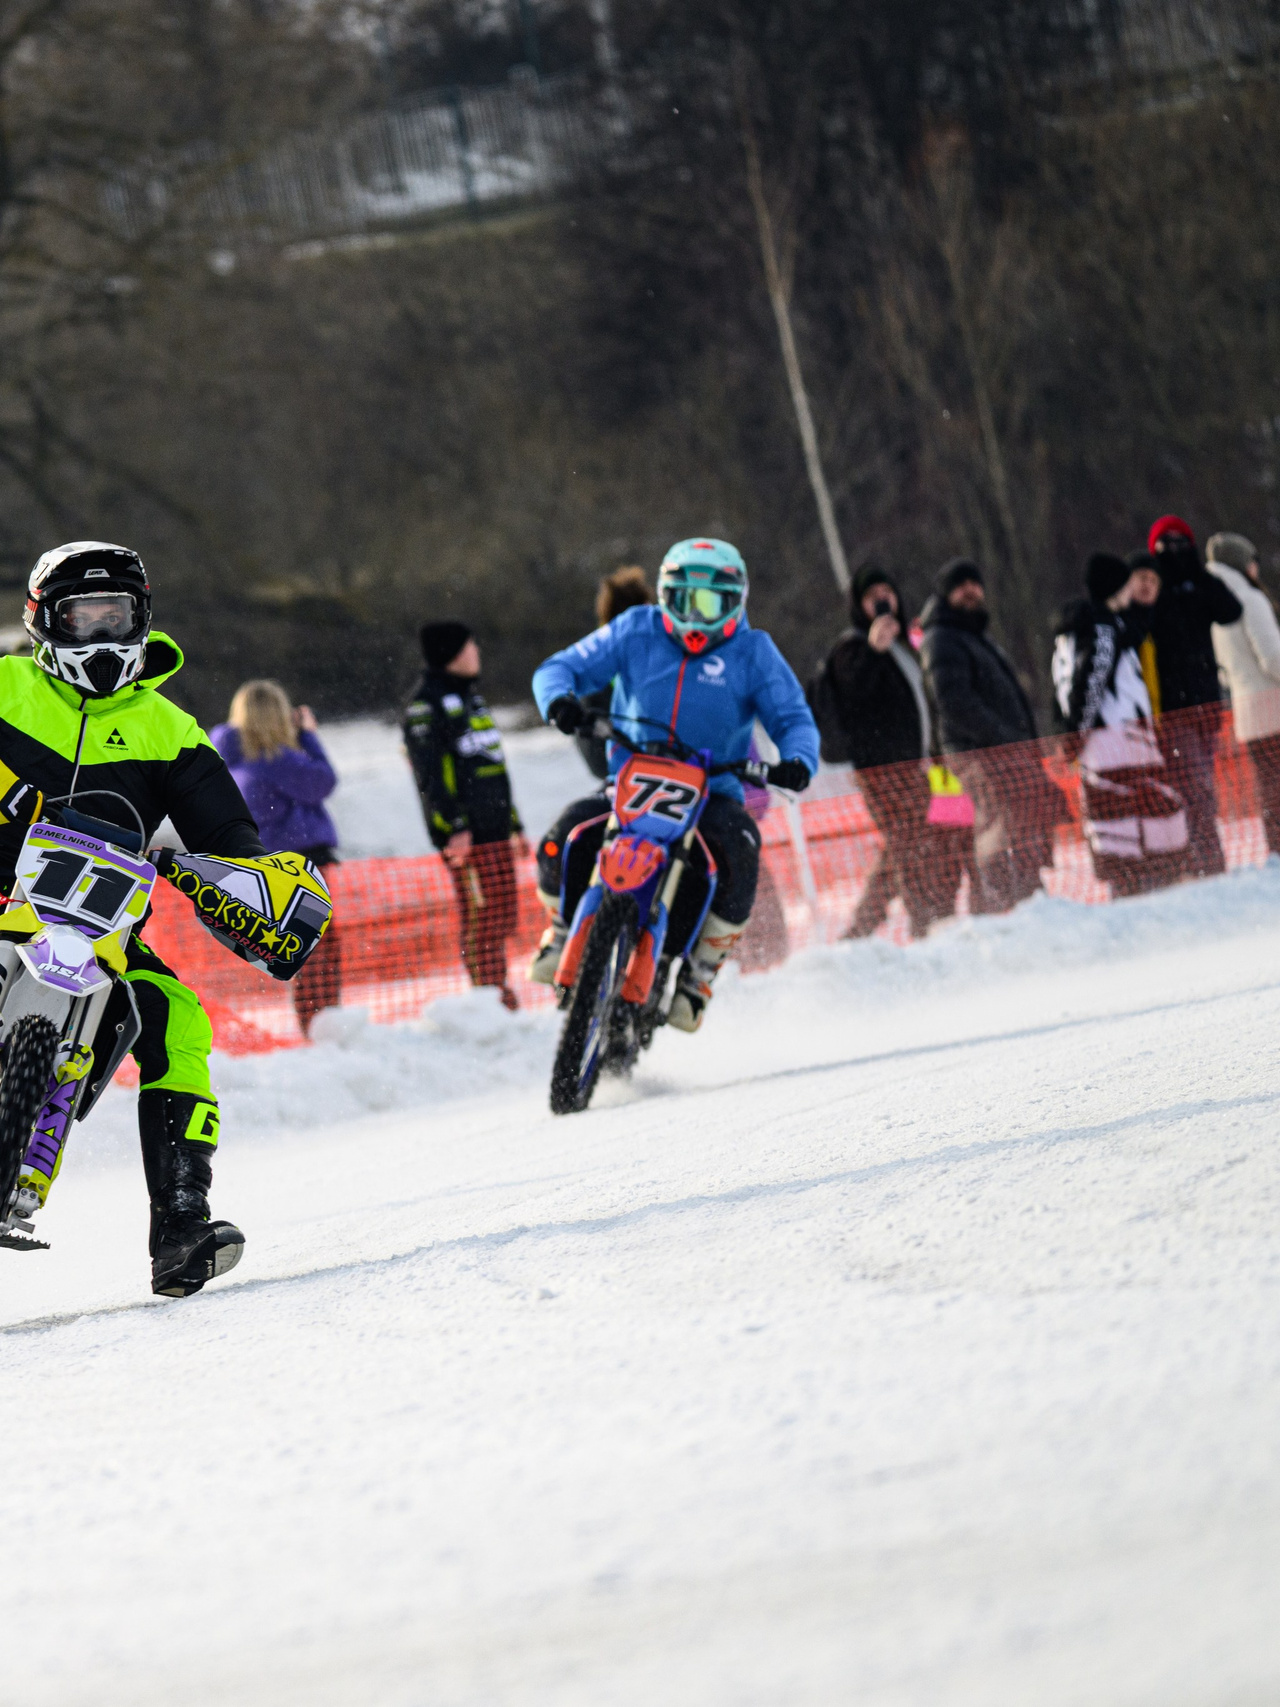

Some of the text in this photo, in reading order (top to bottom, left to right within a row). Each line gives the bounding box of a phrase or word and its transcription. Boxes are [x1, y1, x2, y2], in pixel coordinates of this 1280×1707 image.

[623, 773, 699, 825] 72
[34, 828, 103, 851] D.MELNIKOV
[29, 848, 141, 925] 11
[228, 930, 277, 964] DRINK
